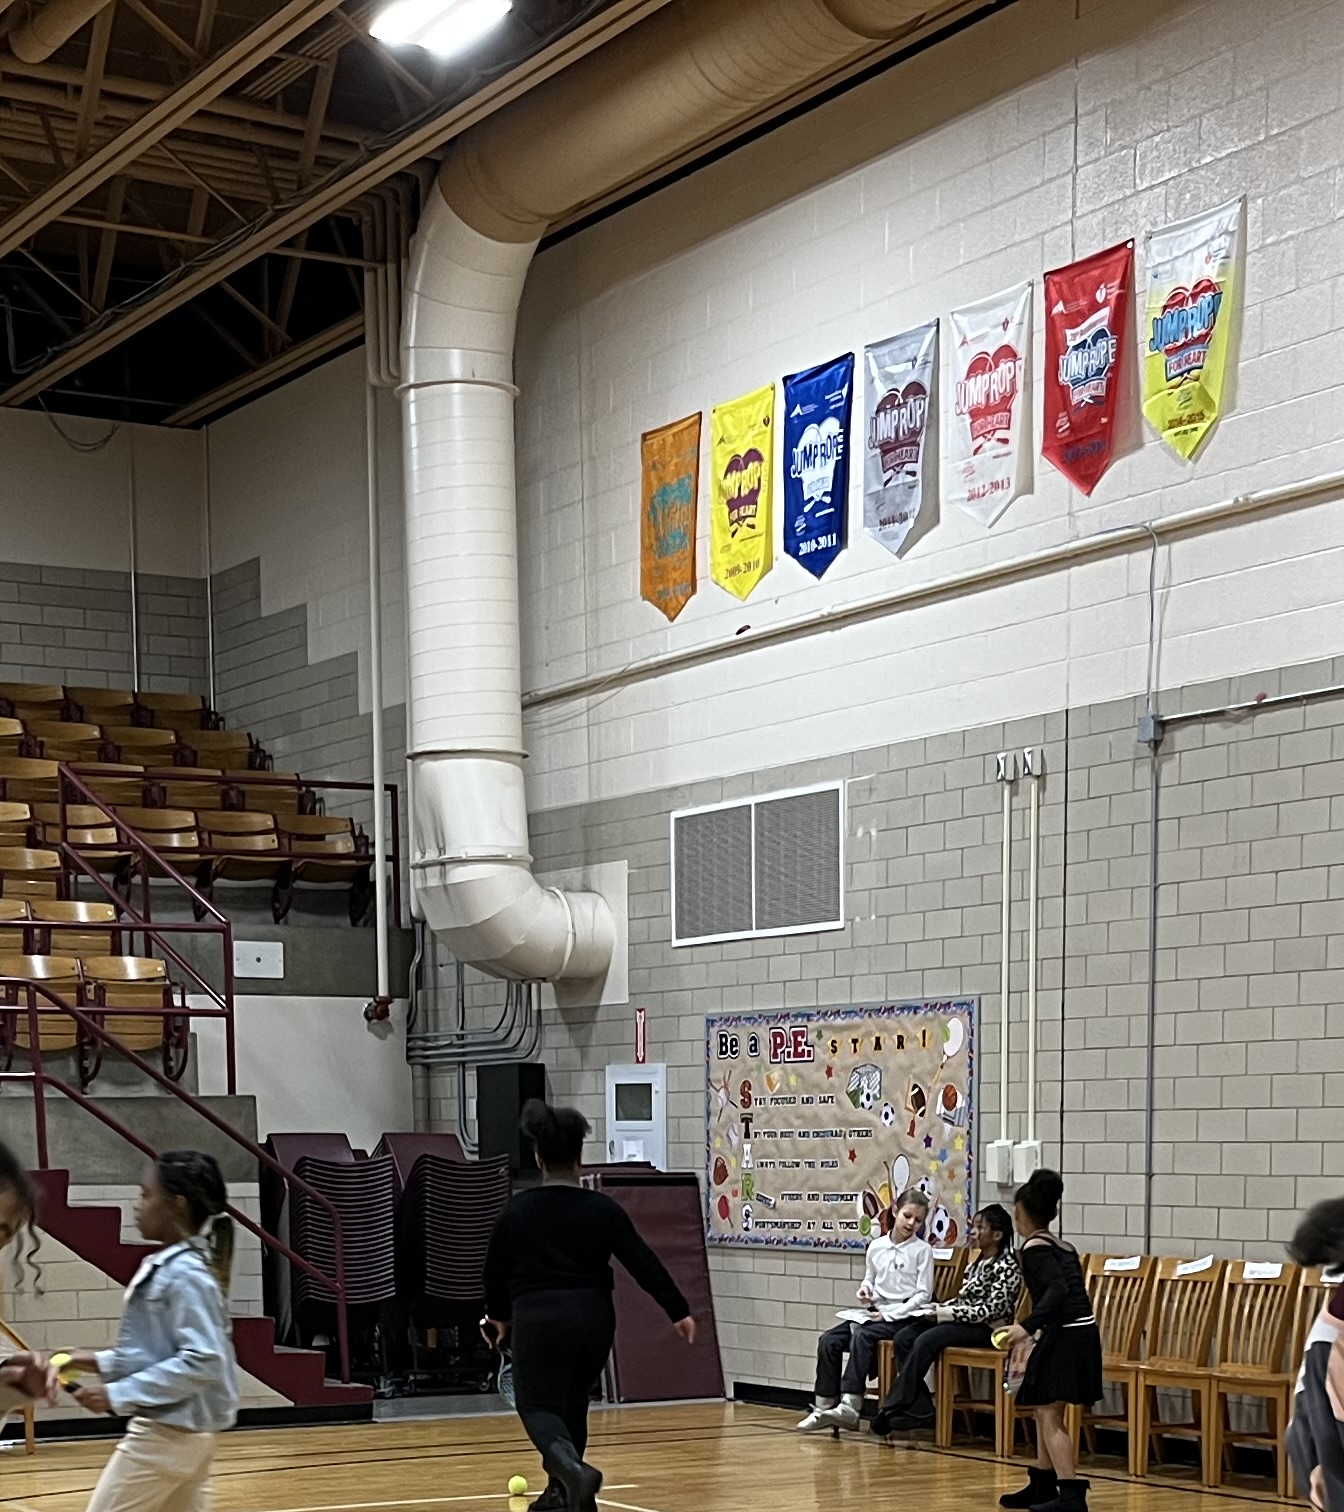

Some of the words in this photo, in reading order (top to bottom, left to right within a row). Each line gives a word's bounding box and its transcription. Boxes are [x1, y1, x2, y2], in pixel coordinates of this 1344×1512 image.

[798, 532, 837, 556] 2010-2011
[717, 1030, 740, 1060] Be
[747, 1032, 760, 1057] a
[769, 1025, 814, 1064] P.E.
